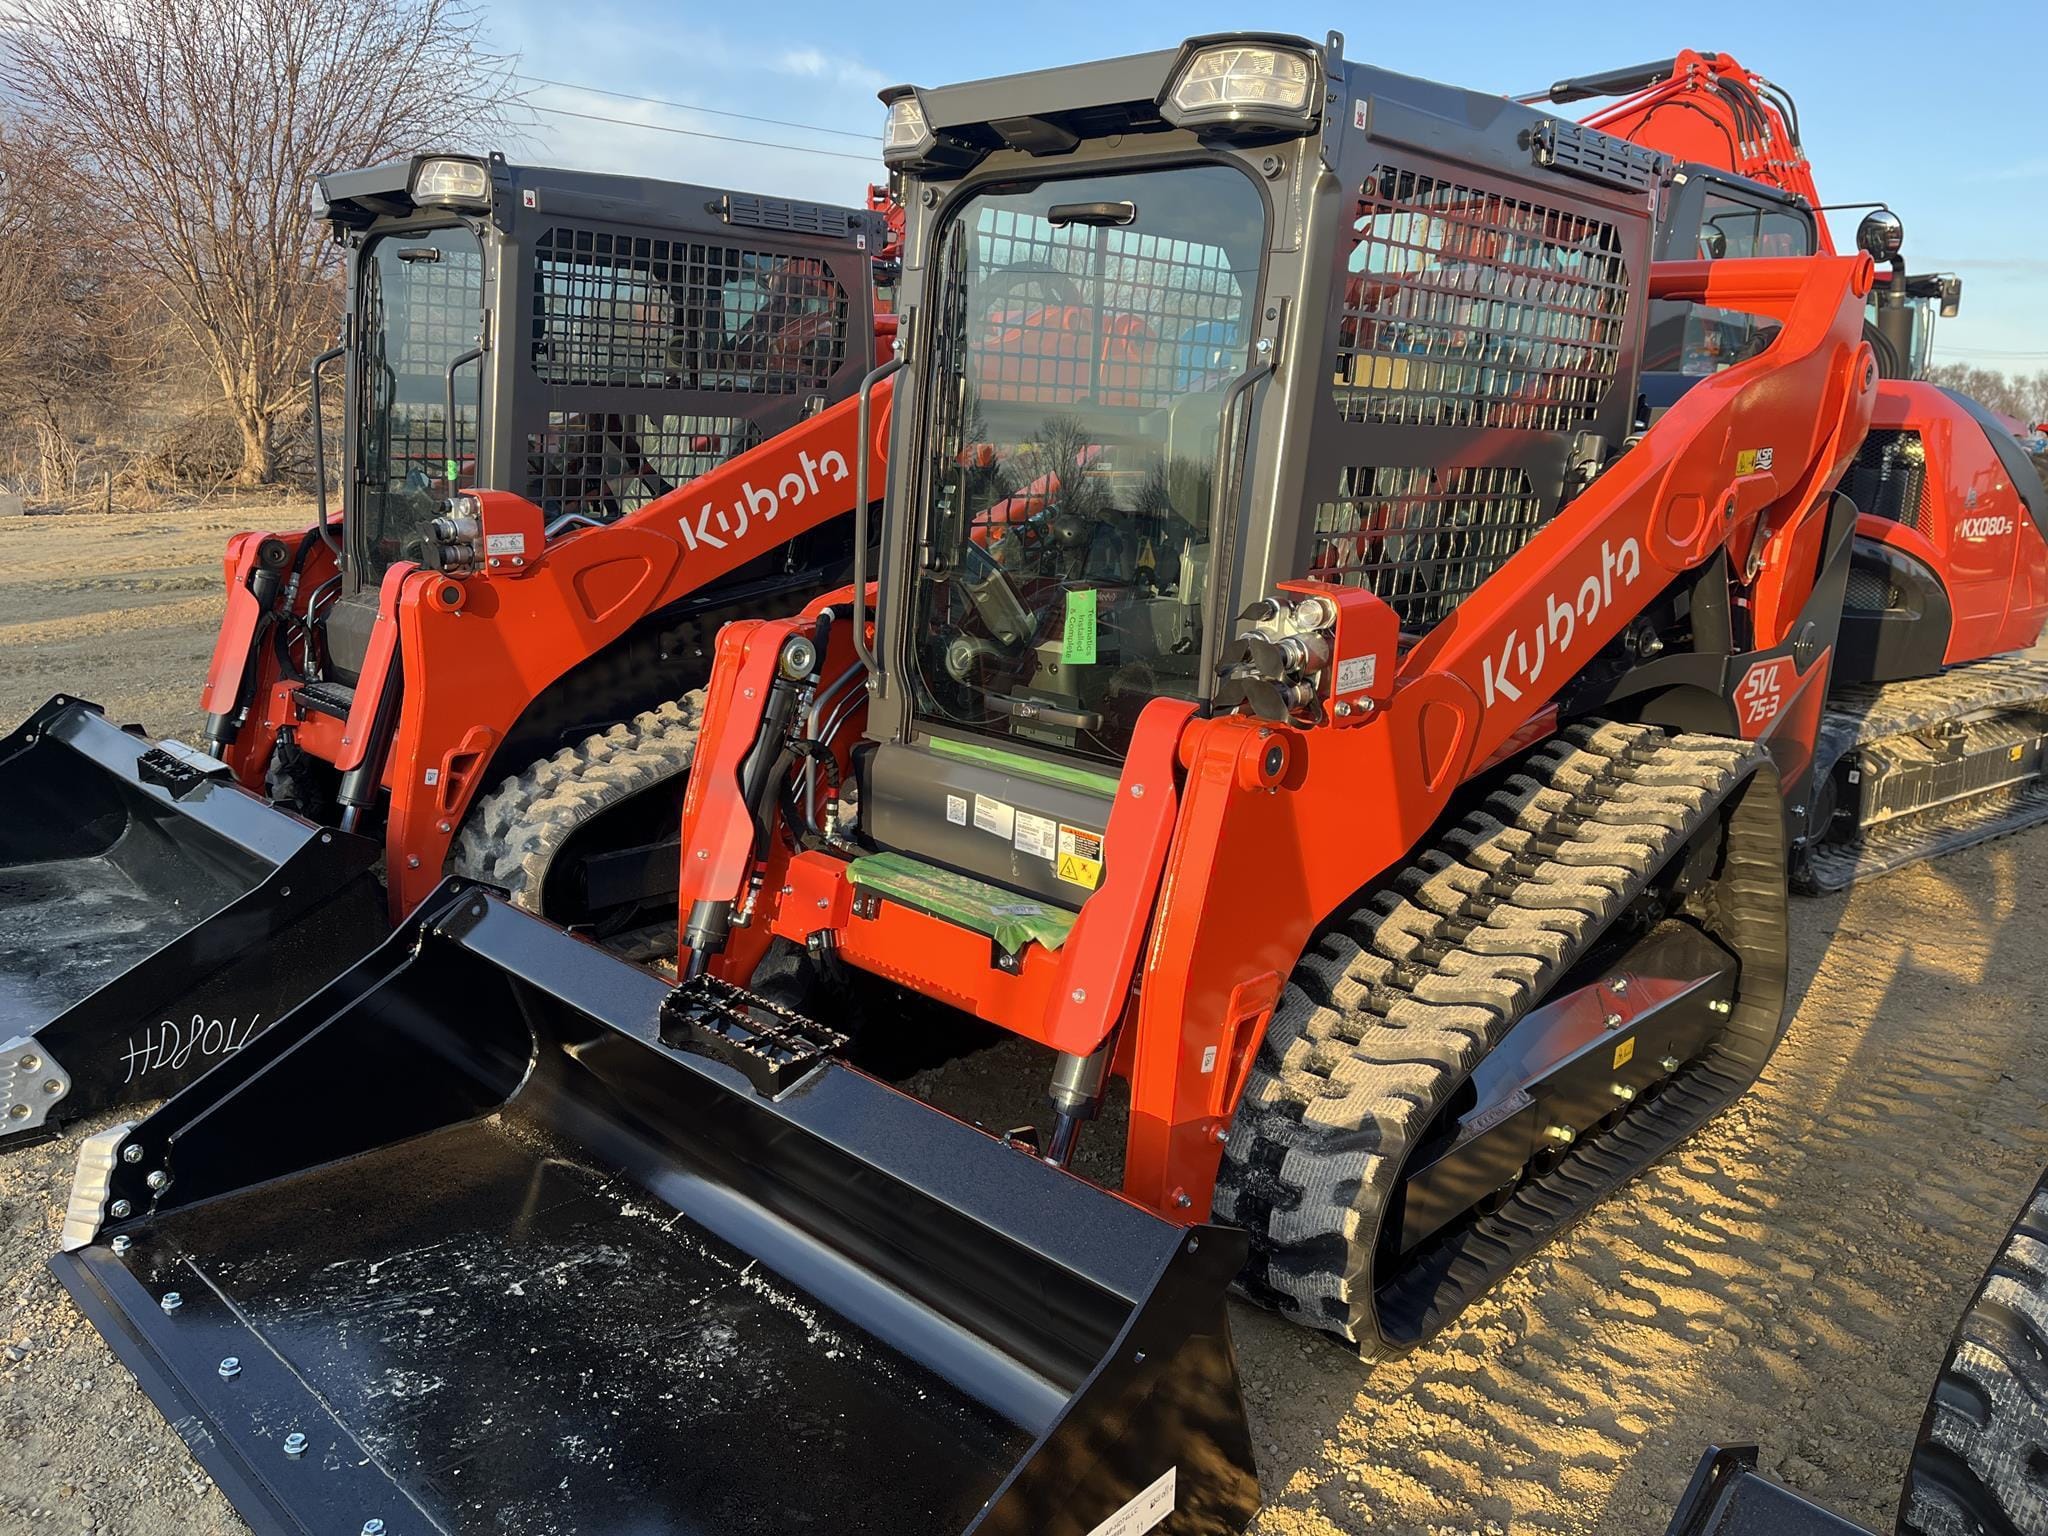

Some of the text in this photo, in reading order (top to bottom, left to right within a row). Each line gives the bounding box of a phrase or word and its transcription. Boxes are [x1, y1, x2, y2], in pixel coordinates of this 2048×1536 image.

[678, 450, 849, 551] Kubota
[1961, 516, 2014, 538] KX080-5
[1065, 617, 1076, 659] Complete
[1076, 614, 1085, 652] Installed
[1086, 608, 1095, 656] Telematics
[1482, 537, 1640, 709] Kubota
[1744, 665, 1781, 700] SVL
[1747, 695, 1780, 724] 75-3
